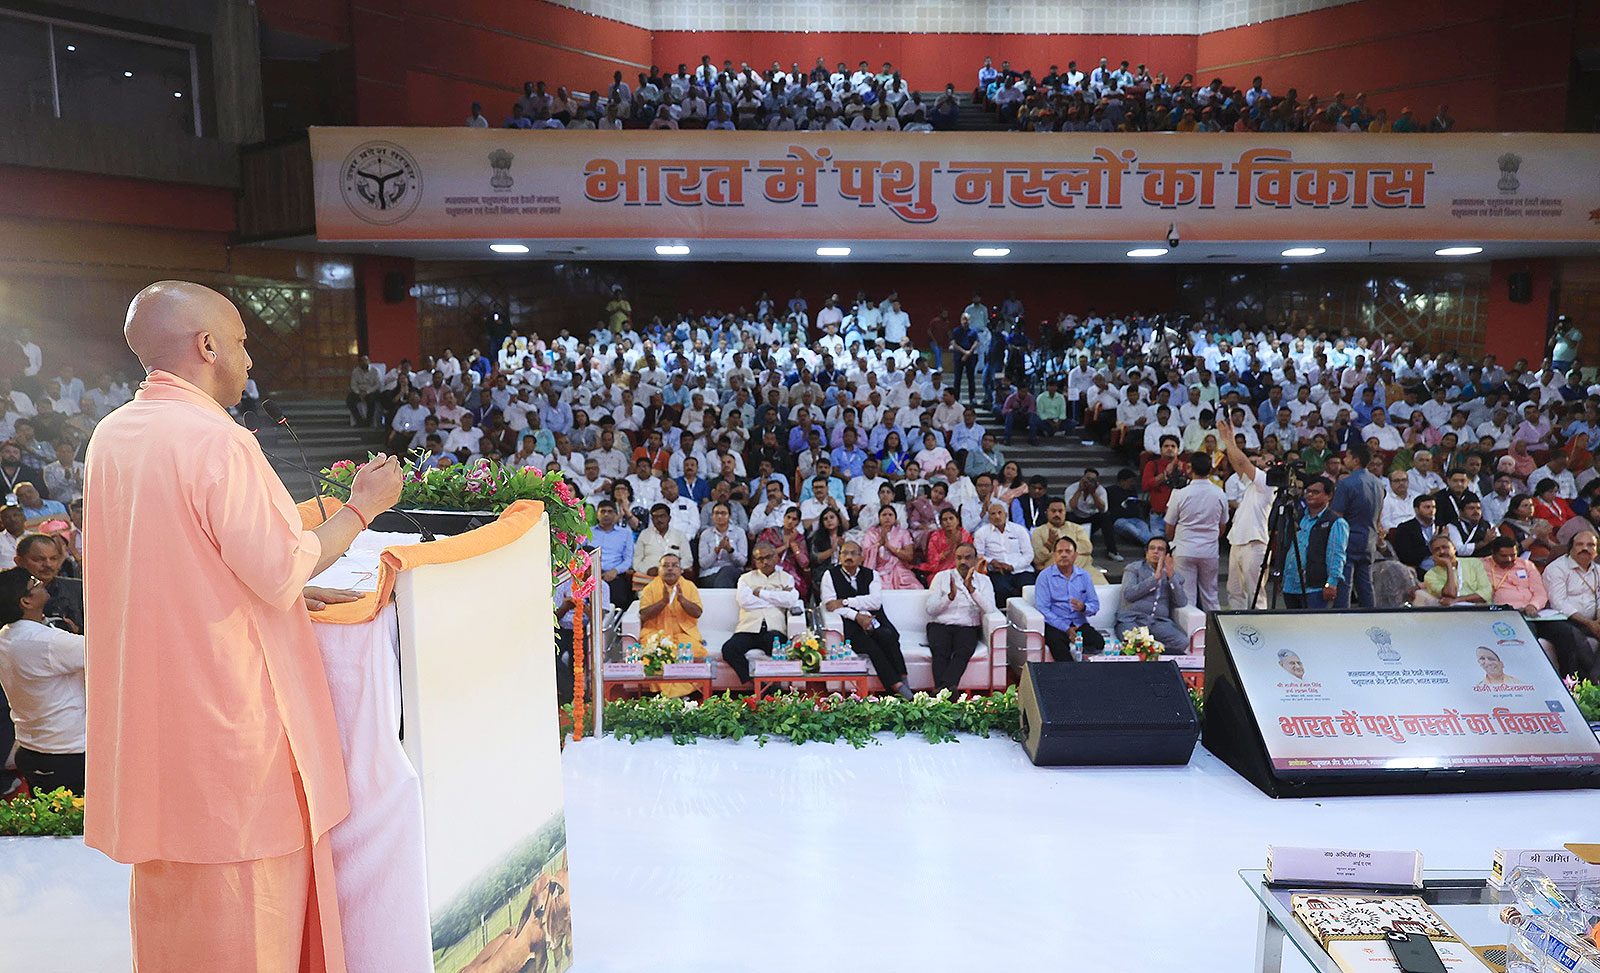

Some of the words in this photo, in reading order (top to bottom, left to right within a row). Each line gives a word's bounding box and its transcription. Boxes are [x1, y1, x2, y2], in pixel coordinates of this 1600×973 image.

[583, 158, 751, 207] भारत
[757, 145, 833, 207] में
[832, 159, 941, 222] पशु
[948, 147, 1136, 209] नस्लों
[1137, 162, 1223, 209] का
[1231, 148, 1433, 209] विकास
[1278, 715, 1338, 738] भारत
[1335, 709, 1363, 738] में
[1361, 715, 1406, 744] पशु
[1398, 709, 1463, 737] नस्लों
[1461, 714, 1496, 736] का
[1493, 707, 1568, 735] विकास
[1530, 853, 1541, 863] श्री
[1545, 853, 1569, 863] अमित
